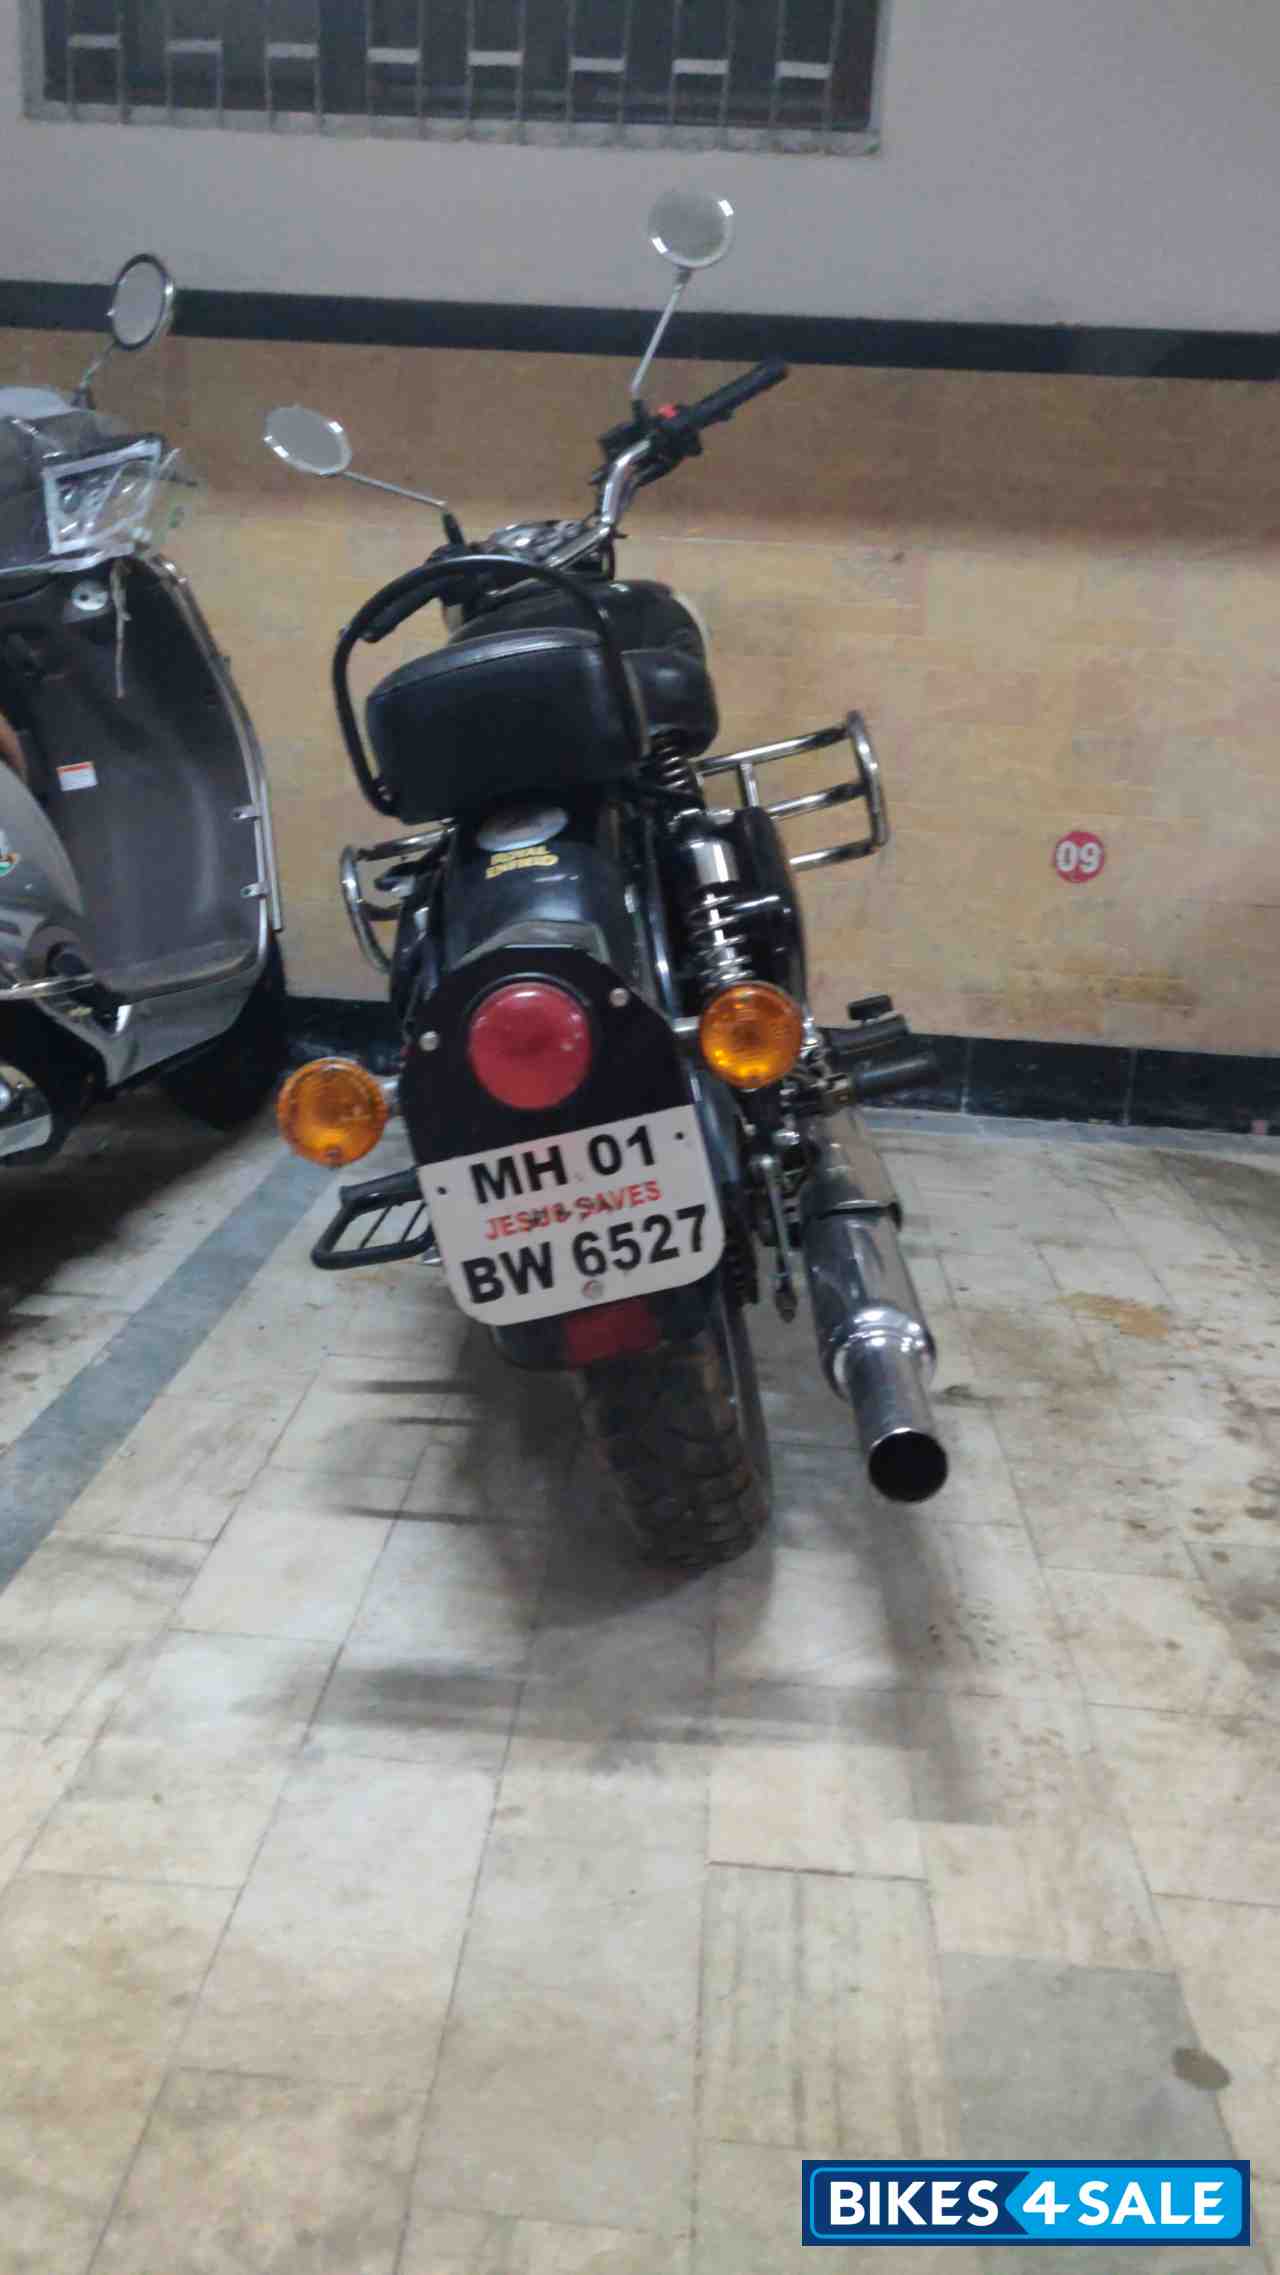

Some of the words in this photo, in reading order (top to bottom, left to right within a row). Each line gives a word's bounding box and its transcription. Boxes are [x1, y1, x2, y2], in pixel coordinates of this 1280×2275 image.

[1056, 840, 1101, 873] 09
[469, 1144, 569, 1205] MH
[587, 1124, 656, 1177] 01
[575, 1180, 662, 1220] SAVES
[461, 1241, 555, 1305] BW
[571, 1203, 706, 1278] 6527
